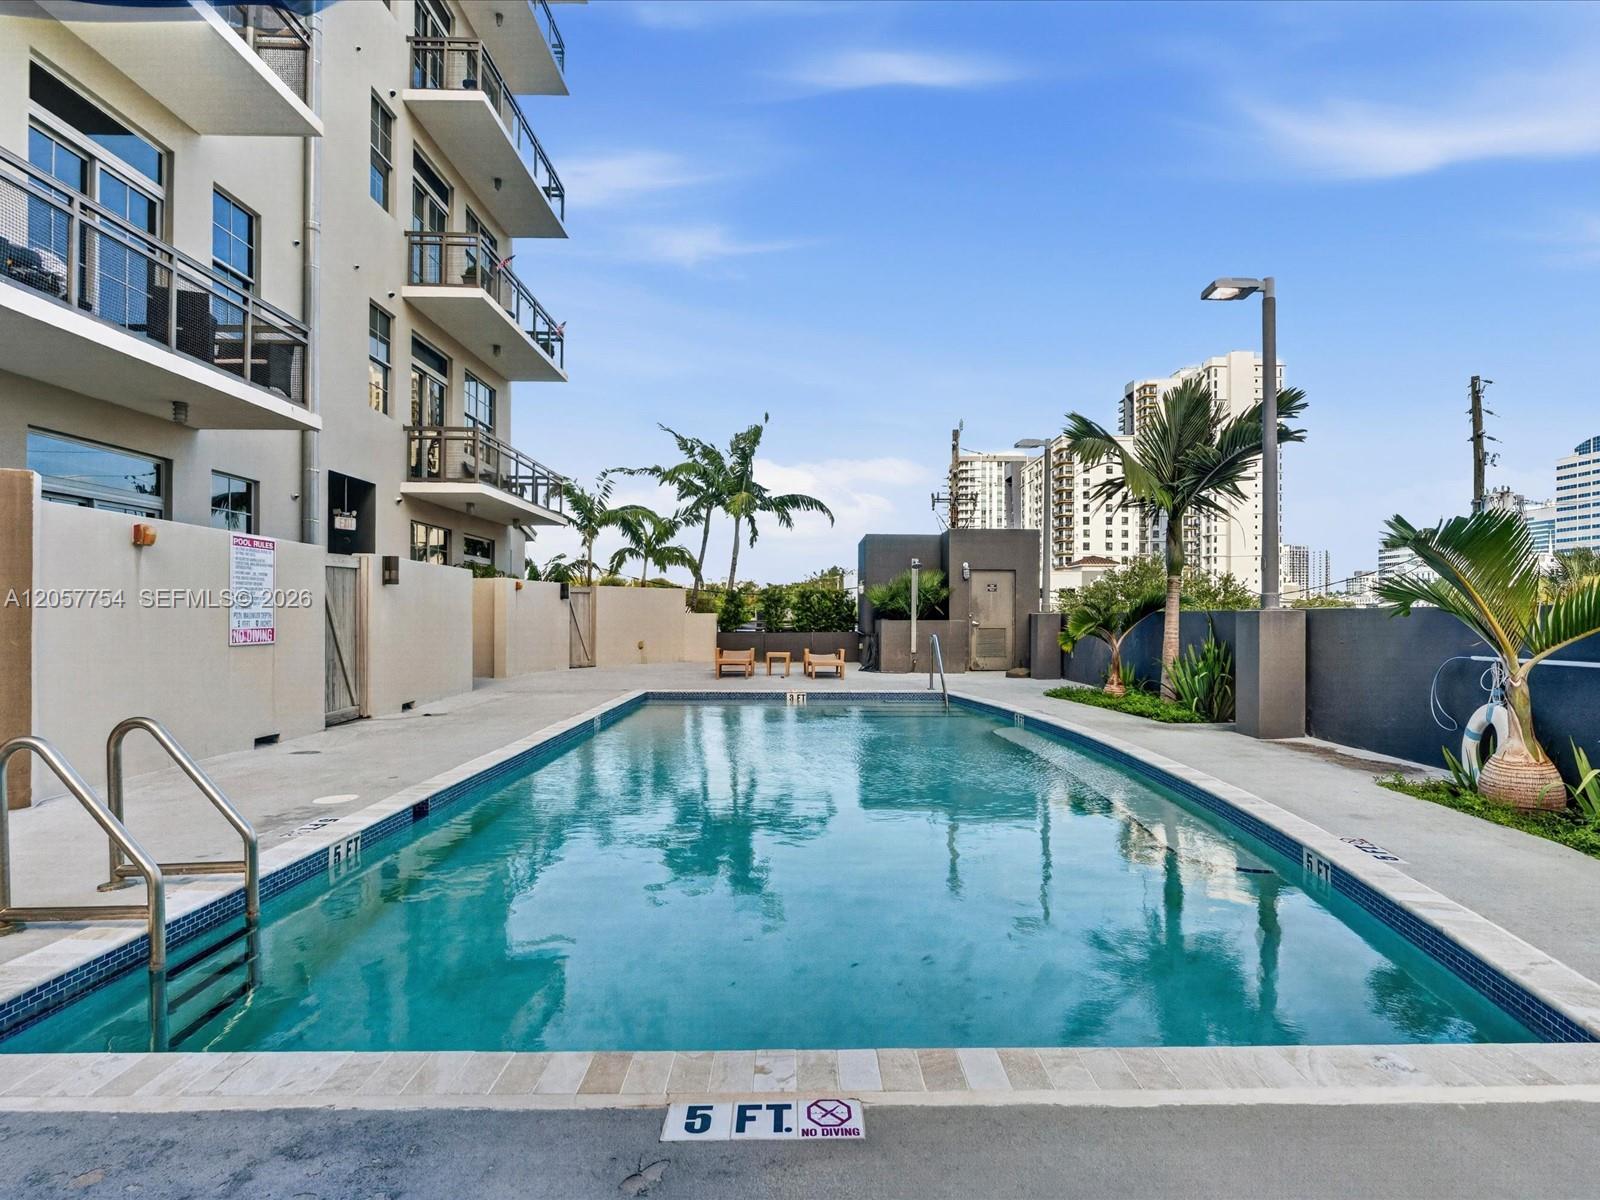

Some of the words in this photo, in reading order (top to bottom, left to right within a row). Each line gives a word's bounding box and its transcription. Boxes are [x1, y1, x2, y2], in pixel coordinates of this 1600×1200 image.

[233, 537, 253, 547] POOL
[253, 541, 273, 549] RULES
[232, 630, 244, 642] NO
[247, 629, 272, 642] DIVING
[1317, 859, 1330, 881] FT
[684, 1105, 714, 1134] 5
[735, 1103, 793, 1133] FT.
[801, 1127, 818, 1137] NO
[821, 1127, 861, 1137] DIVING
